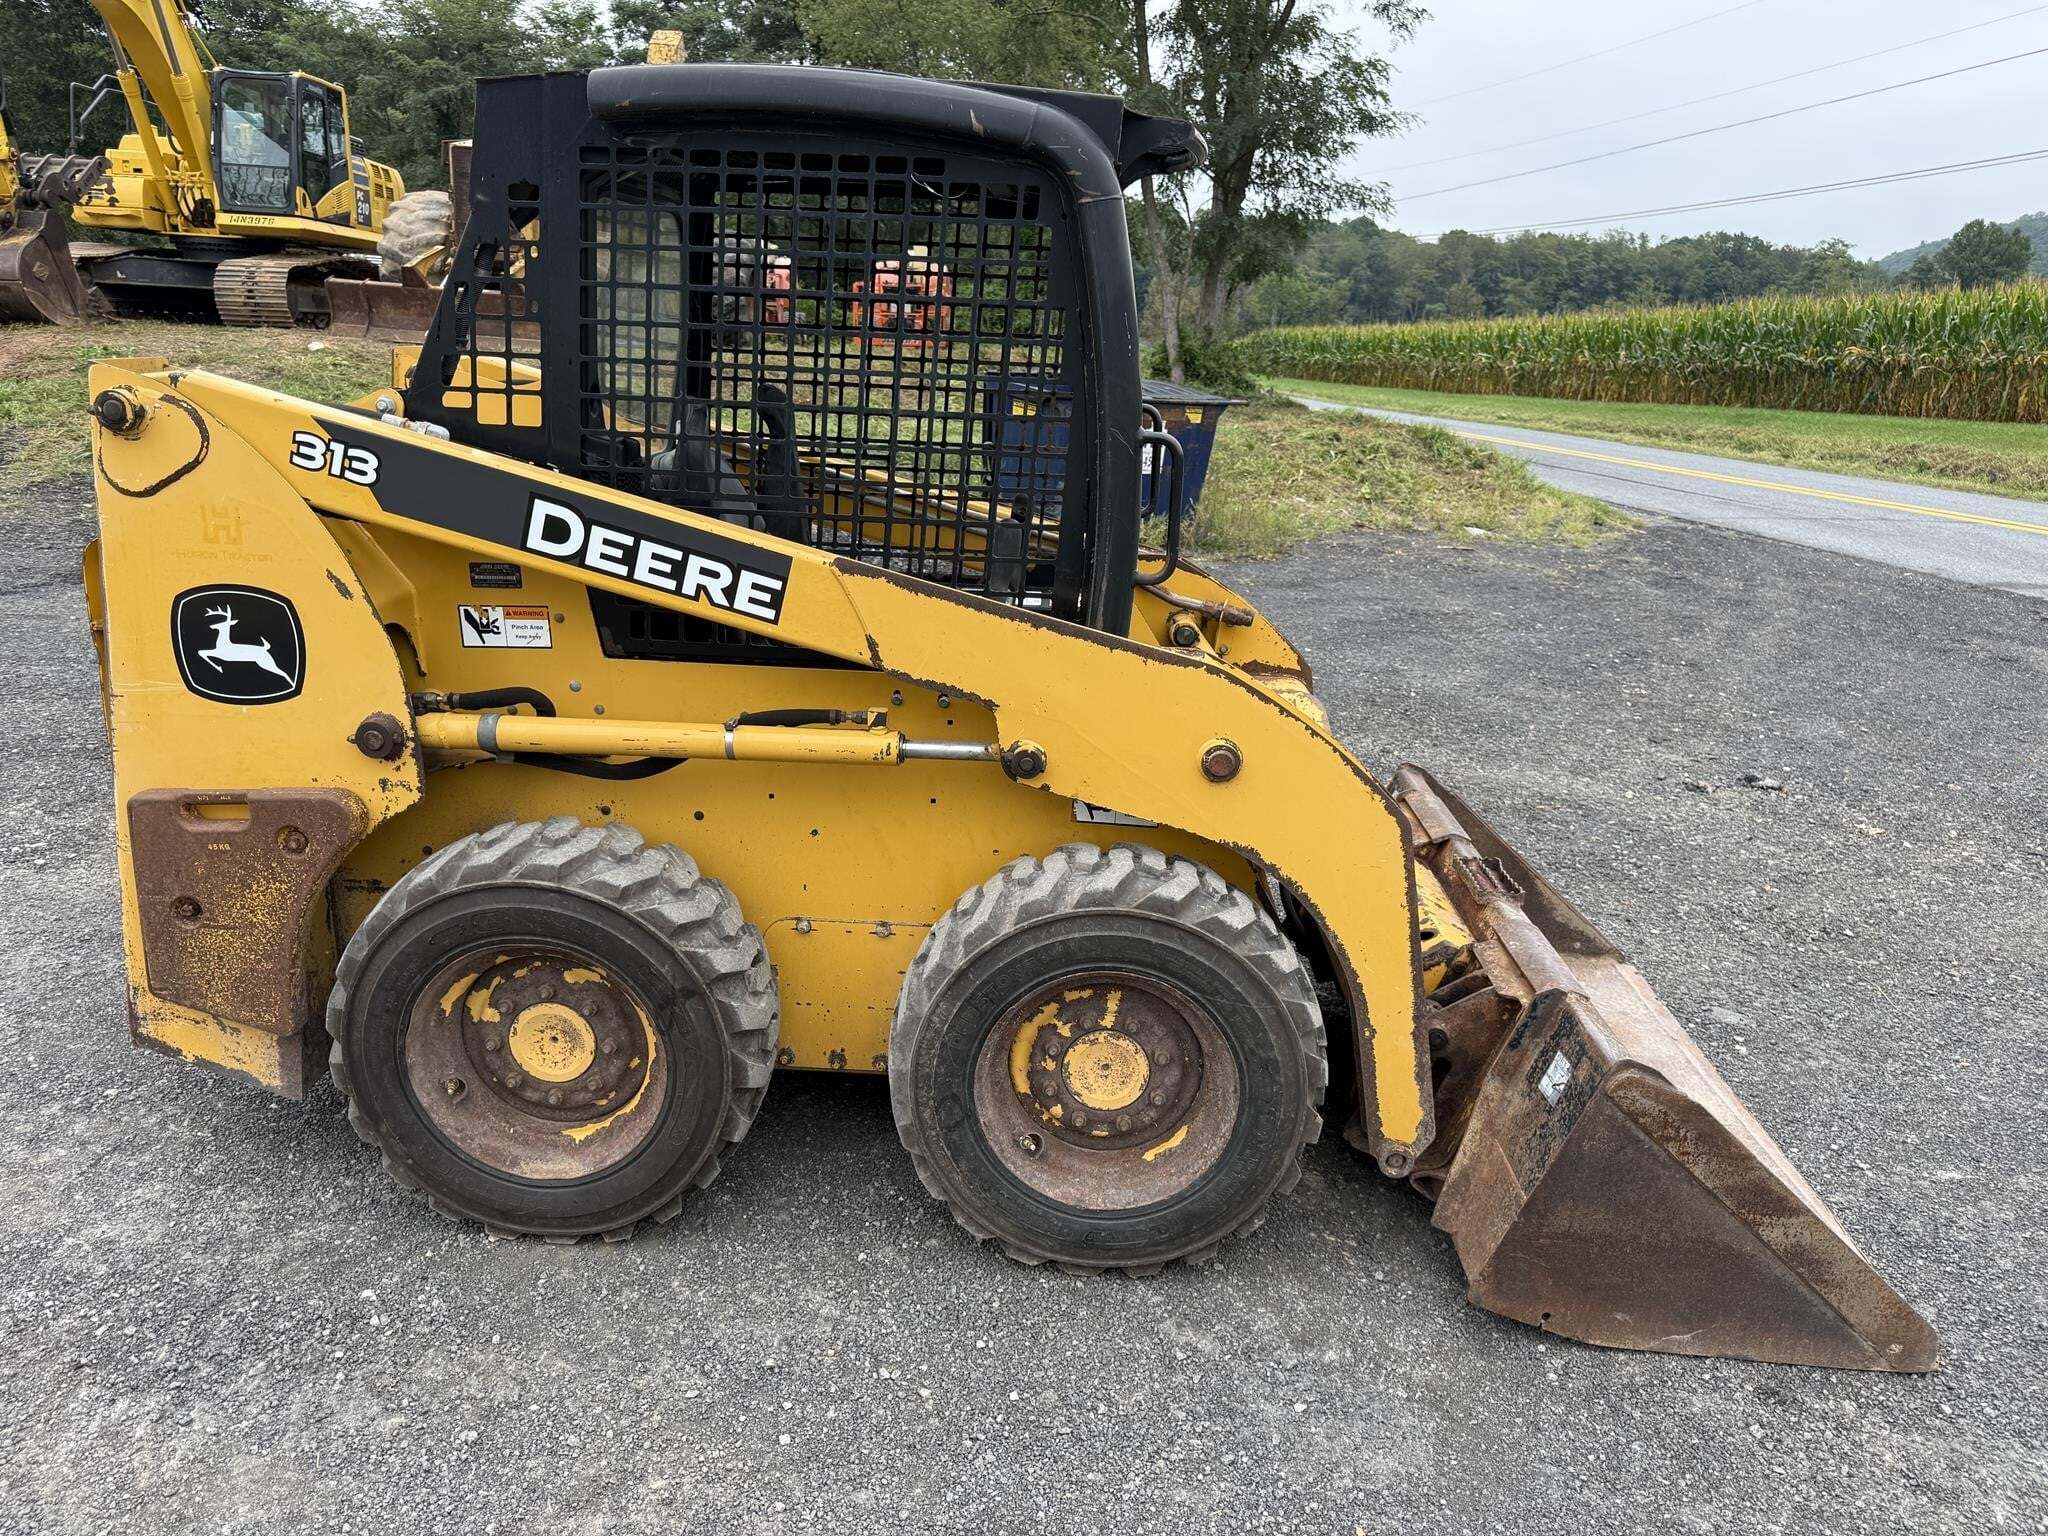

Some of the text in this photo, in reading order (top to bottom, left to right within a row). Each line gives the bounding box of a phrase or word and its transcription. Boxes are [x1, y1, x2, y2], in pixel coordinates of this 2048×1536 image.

[357, 201, 370, 215] 210
[290, 432, 380, 486] 313
[526, 498, 783, 621] DEERE
